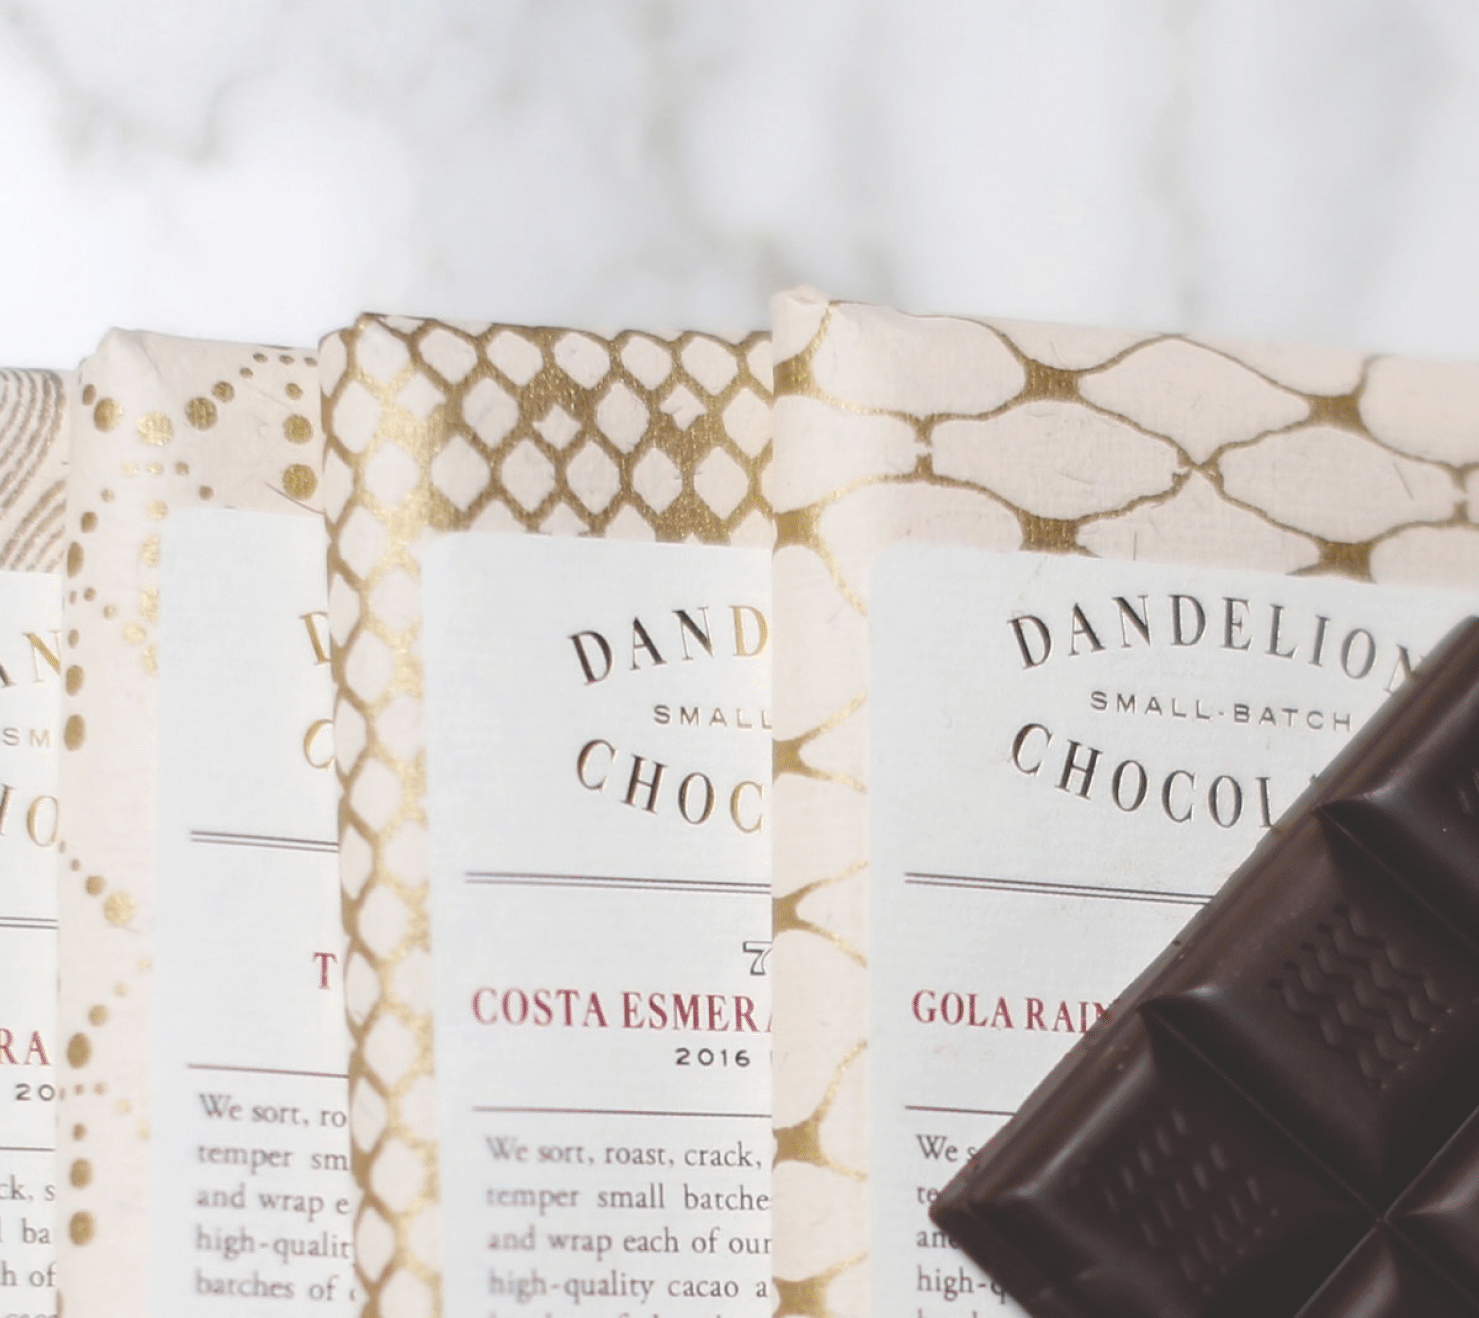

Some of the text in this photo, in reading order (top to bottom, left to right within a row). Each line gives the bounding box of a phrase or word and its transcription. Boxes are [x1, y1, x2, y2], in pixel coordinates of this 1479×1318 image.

[1089, 689, 1355, 733] SMALL-BATCH
[470, 988, 772, 1033] COSTA ESMER
[911, 989, 1014, 1029] GOLA
[674, 1046, 751, 1068] 2016
[196, 1143, 294, 1176] temper
[257, 1192, 325, 1223] wrap
[596, 1181, 665, 1209] small
[622, 1225, 680, 1253] each
[690, 1225, 720, 1254] of
[666, 1279, 740, 1298] cacao
